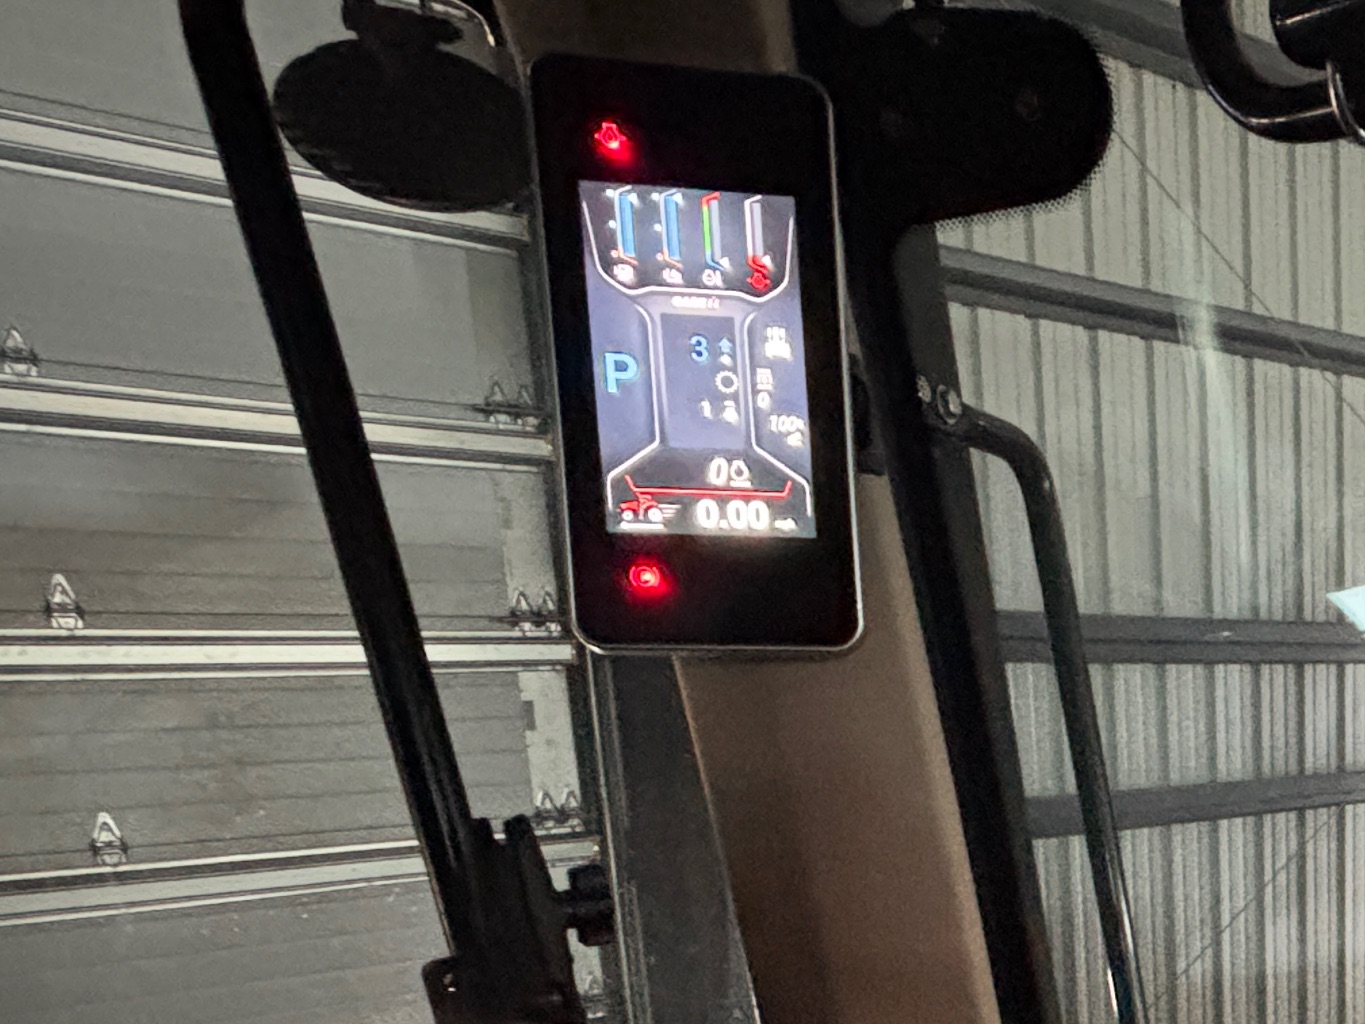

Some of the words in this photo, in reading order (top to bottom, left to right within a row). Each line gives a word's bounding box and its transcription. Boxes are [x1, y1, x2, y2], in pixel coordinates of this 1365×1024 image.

[688, 335, 709, 362] 3
[604, 352, 638, 394] P
[700, 399, 712, 419] 1
[709, 456, 728, 486] 0
[696, 498, 770, 531] 0.00
